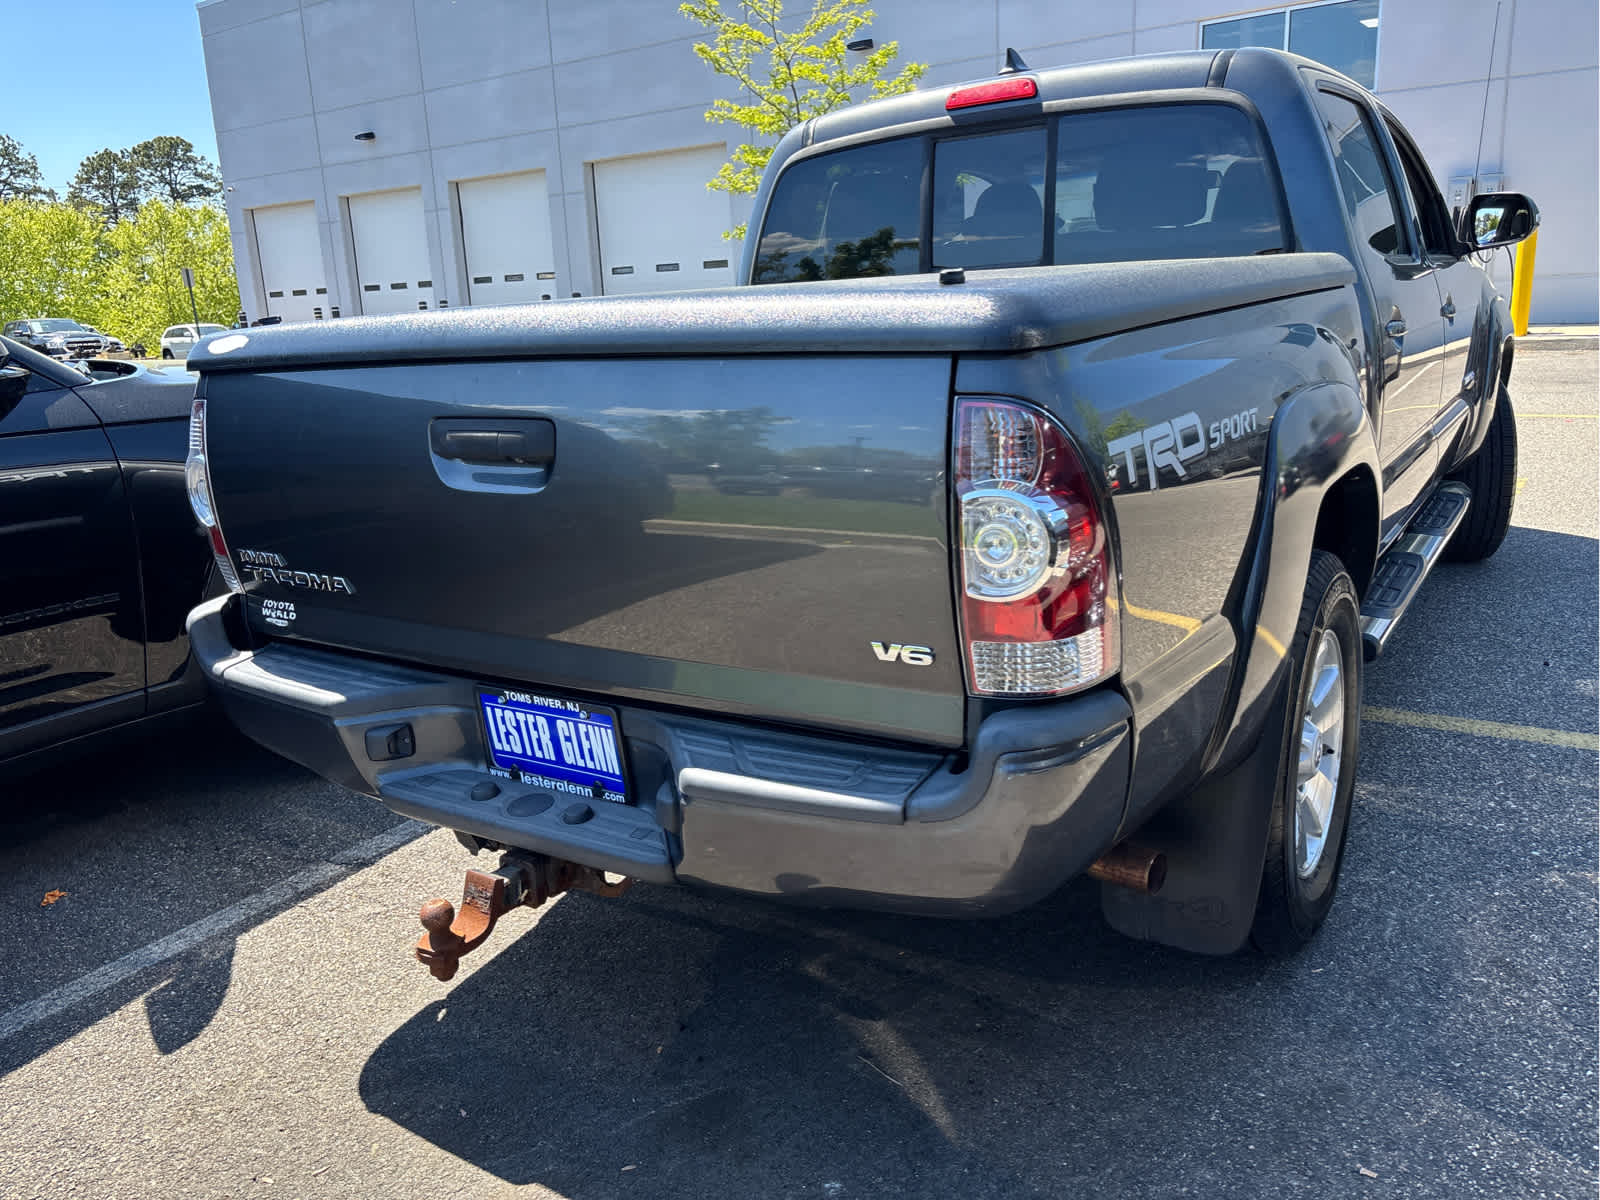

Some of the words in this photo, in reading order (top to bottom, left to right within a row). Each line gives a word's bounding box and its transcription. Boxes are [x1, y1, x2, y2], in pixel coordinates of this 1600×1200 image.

[1107, 411, 1206, 490] TRD
[1209, 407, 1258, 449] SPORT
[243, 565, 355, 594] TACOMA
[263, 599, 295, 612] TOYOTA
[871, 641, 934, 666] V6
[503, 690, 532, 704] TOMS
[566, 701, 580, 713] NJ
[485, 706, 556, 761] LESTER
[556, 719, 621, 775] GLENN
[489, 768, 512, 779] www.
[603, 791, 625, 803] .com
